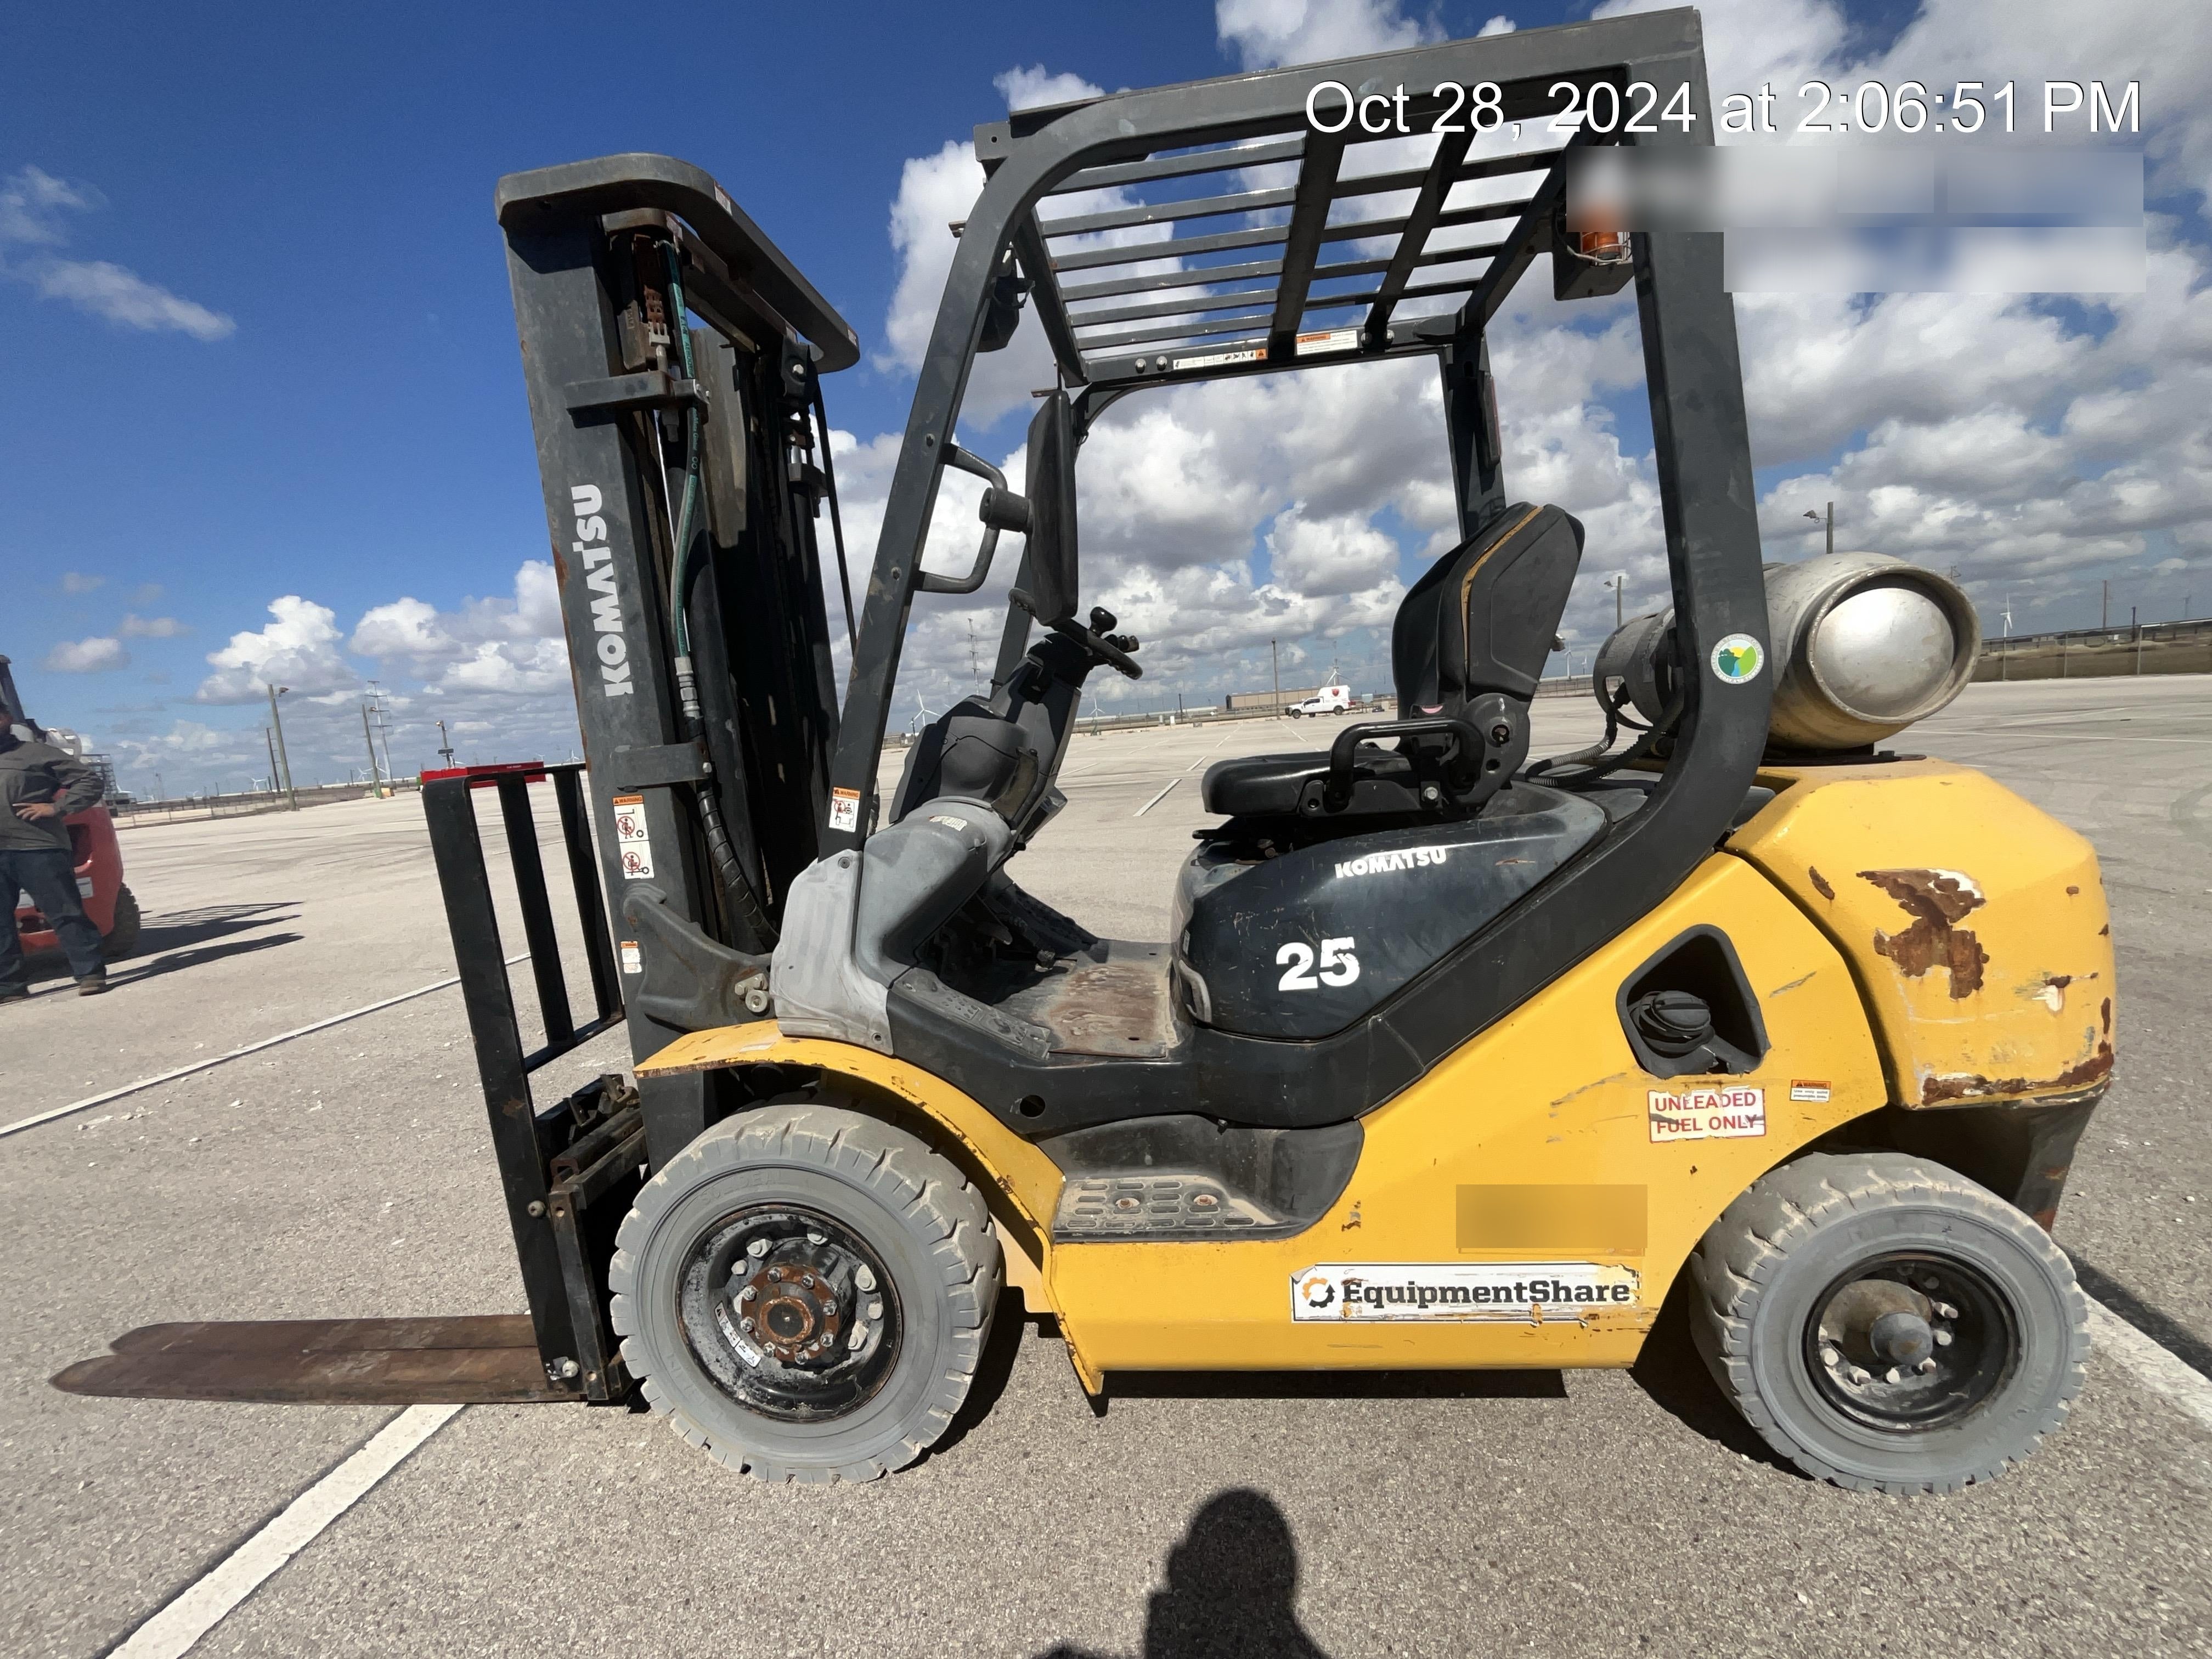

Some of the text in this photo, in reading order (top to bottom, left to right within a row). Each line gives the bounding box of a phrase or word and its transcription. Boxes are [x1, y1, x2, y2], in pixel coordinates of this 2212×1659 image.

[571, 484, 634, 697] KOMATSU
[1335, 847, 1447, 878] KOMATSU
[1276, 936, 1360, 991] 25
[1655, 1091, 1757, 1112] UNLEADED
[1657, 1115, 1756, 1134] FUEL ONLY
[1342, 1279, 1630, 1309] EquipmentShare
